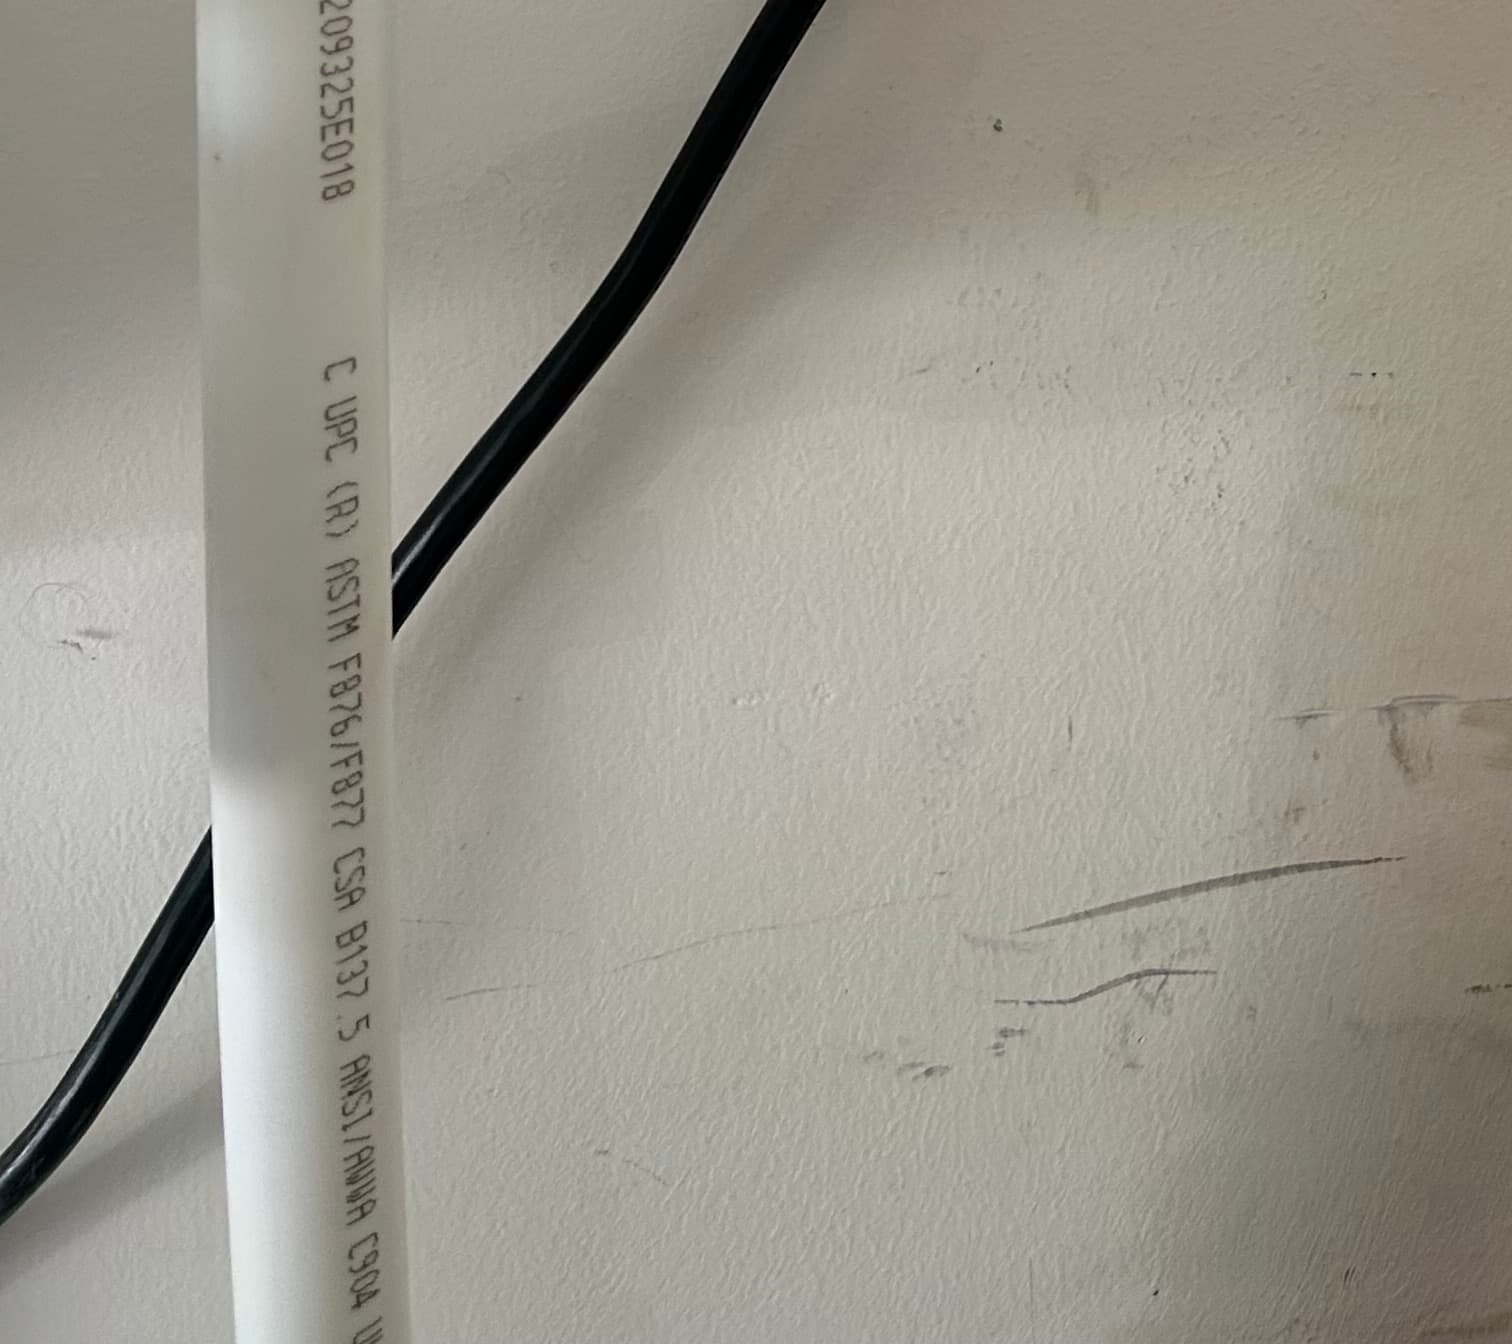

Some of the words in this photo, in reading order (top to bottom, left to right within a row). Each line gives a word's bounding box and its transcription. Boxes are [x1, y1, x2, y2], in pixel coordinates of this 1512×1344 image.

[321, 355, 357, 384] C
[323, 395, 359, 464] UPC
[324, 481, 360, 541] (R)
[324, 557, 361, 643] ASTM
[327, 652, 366, 831] F876/F877
[332, 845, 368, 911] CSA
[339, 1053, 379, 1227] ANSI/AWWA
[347, 1231, 381, 1311] C904
